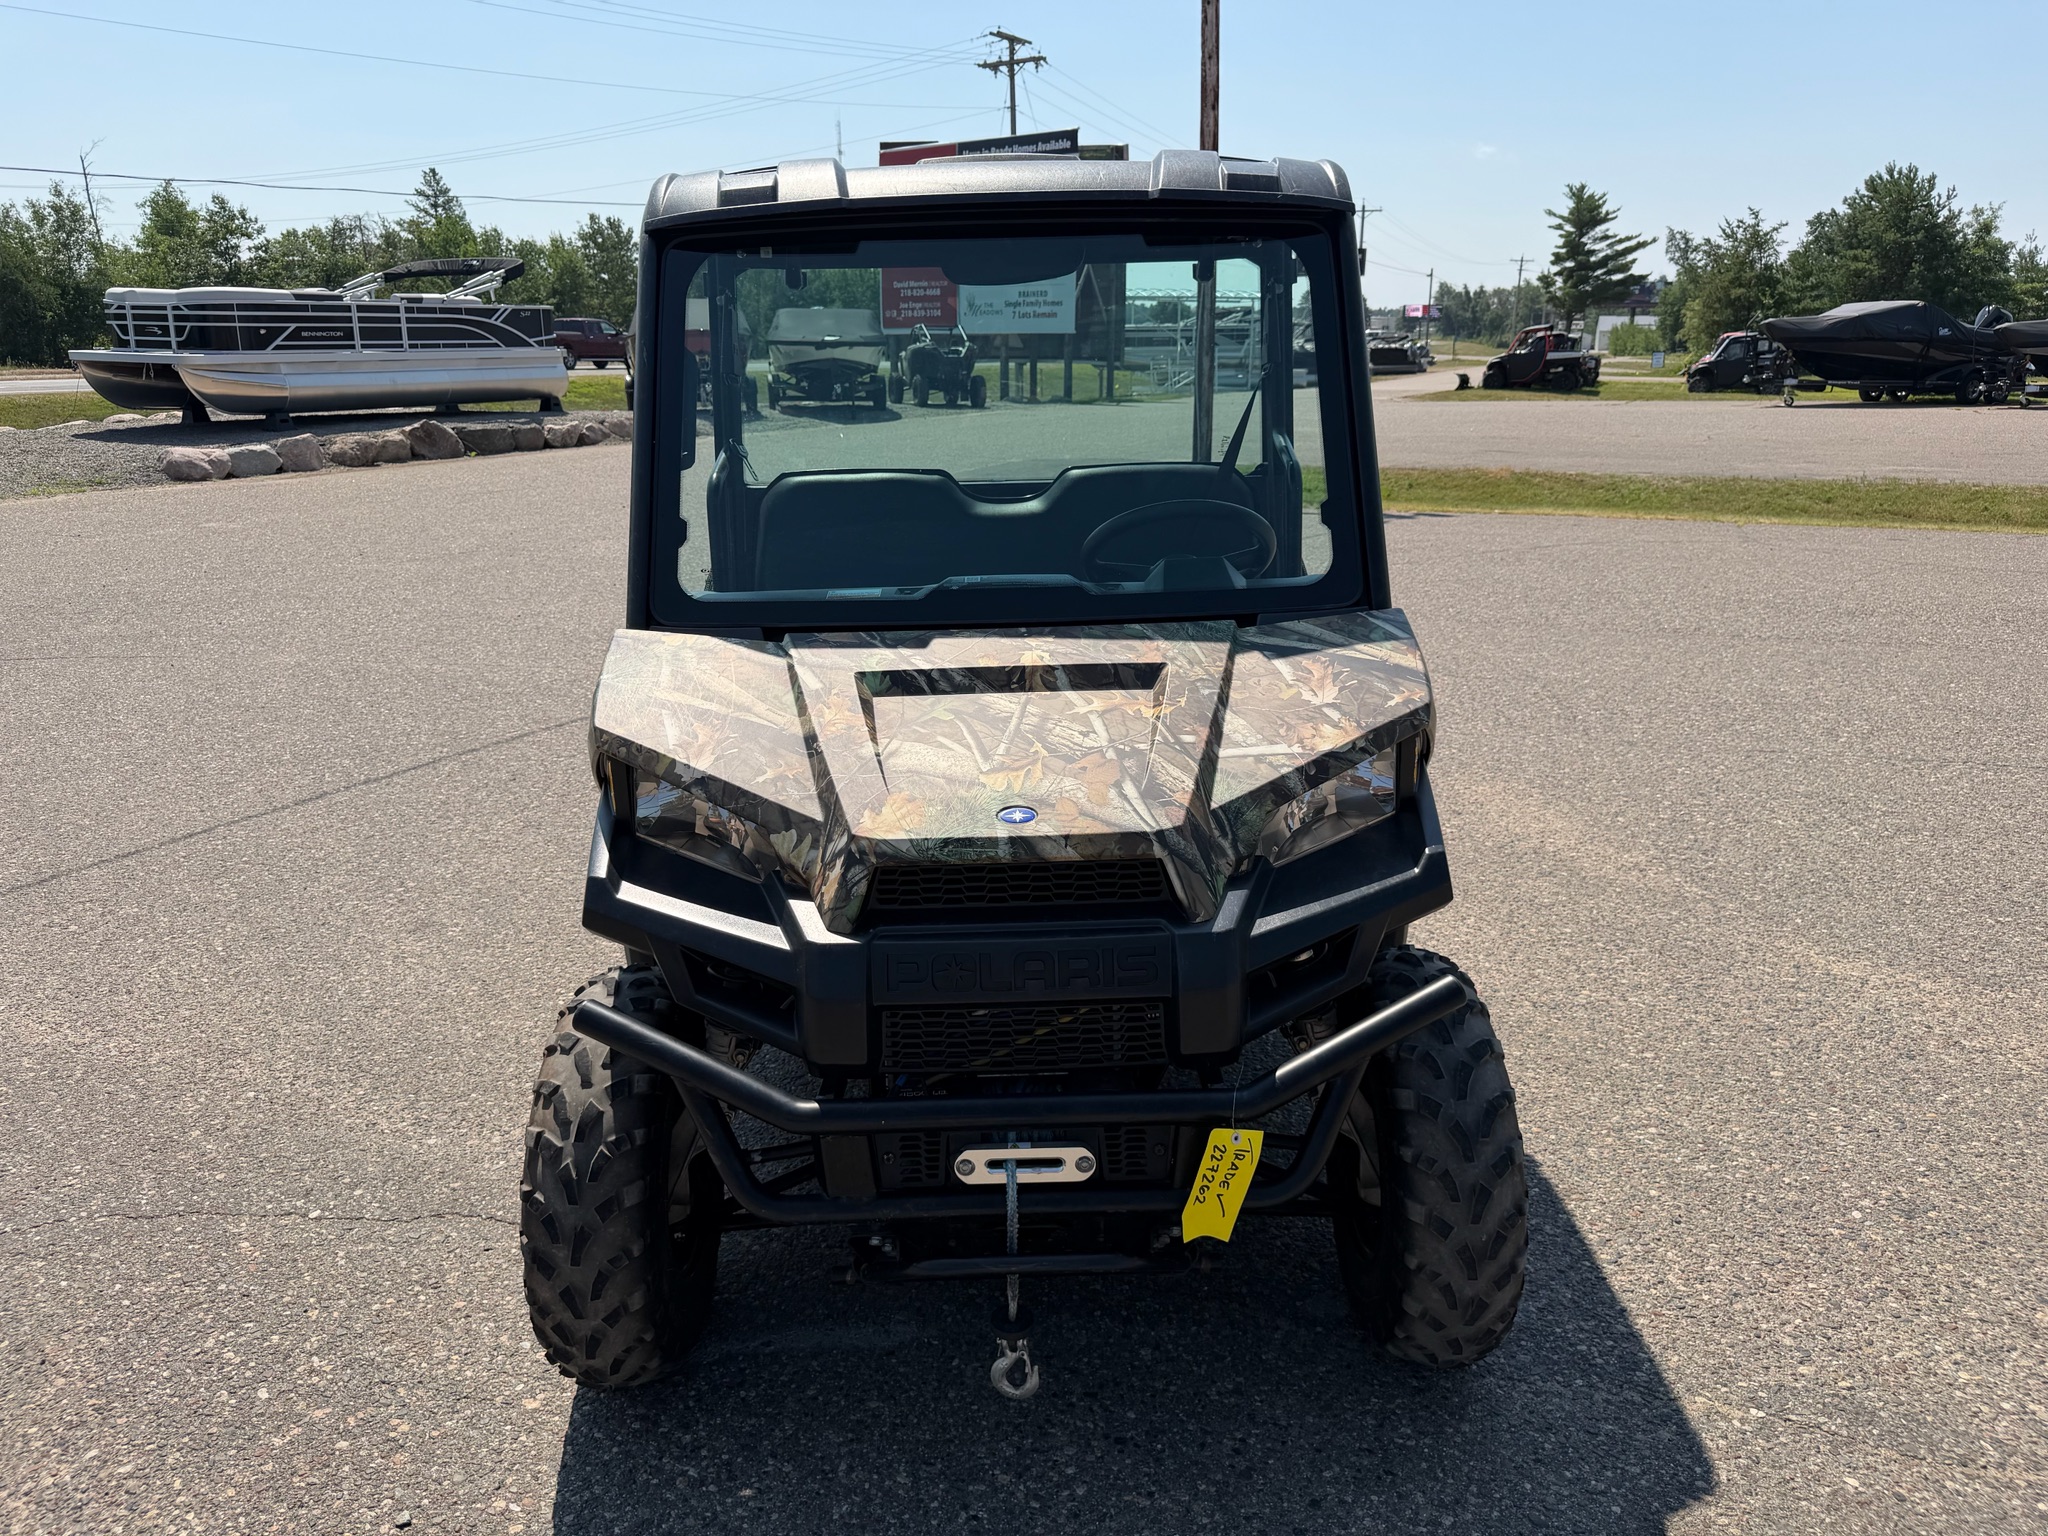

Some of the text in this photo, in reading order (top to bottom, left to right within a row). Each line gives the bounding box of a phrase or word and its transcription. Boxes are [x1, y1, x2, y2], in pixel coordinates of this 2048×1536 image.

[1013, 143, 1036, 153] Homes
[1037, 138, 1071, 152] Available
[1018, 290, 1048, 298] BRAINERD
[1004, 299, 1063, 309] Single Family Homes
[1012, 310, 1057, 319] 7 Lots Remain
[886, 945, 1159, 993] POLARIS
[1193, 1144, 1227, 1206] 227262
